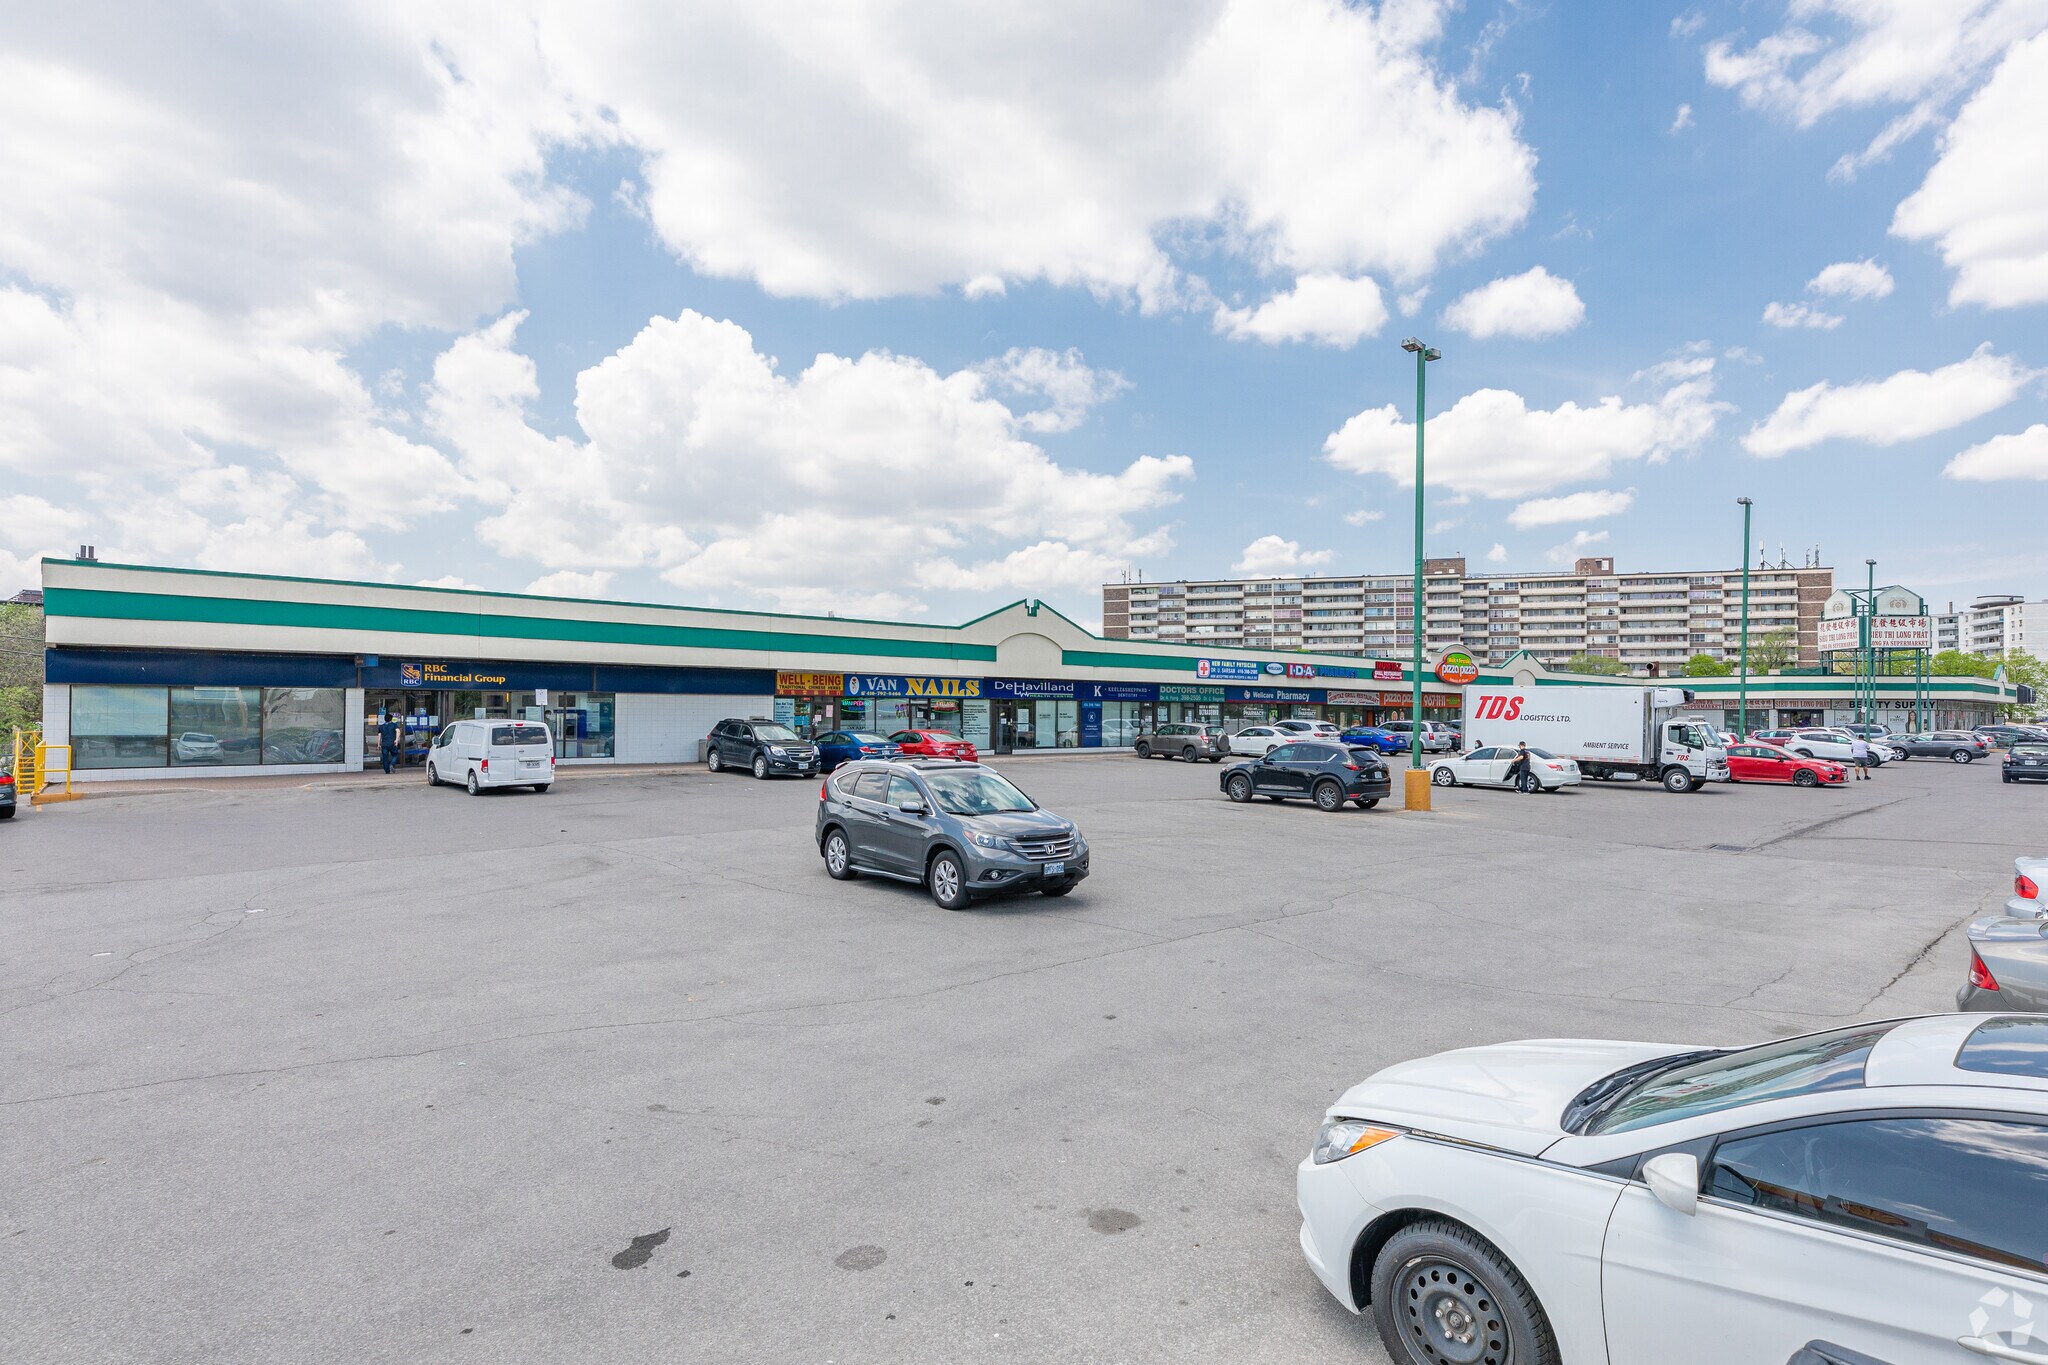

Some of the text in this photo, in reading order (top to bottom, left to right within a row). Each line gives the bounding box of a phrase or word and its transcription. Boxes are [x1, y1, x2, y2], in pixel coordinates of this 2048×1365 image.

[424, 664, 447, 672] RBC
[1320, 667, 1359, 678] PHARMACY
[1442, 664, 1476, 678] pizza pizza
[424, 673, 506, 684] Financial Group
[779, 674, 805, 685] WELL
[813, 675, 841, 686] BEING
[866, 677, 980, 696] VAN NAILS
[994, 682, 1074, 695] DeHavilland
[1094, 685, 1102, 697] K
[1277, 690, 1310, 702] Pharmacy
[1356, 693, 1379, 702] RESTAURANT
[1384, 693, 1400, 702] pizza
[1475, 696, 1524, 720] TDS
